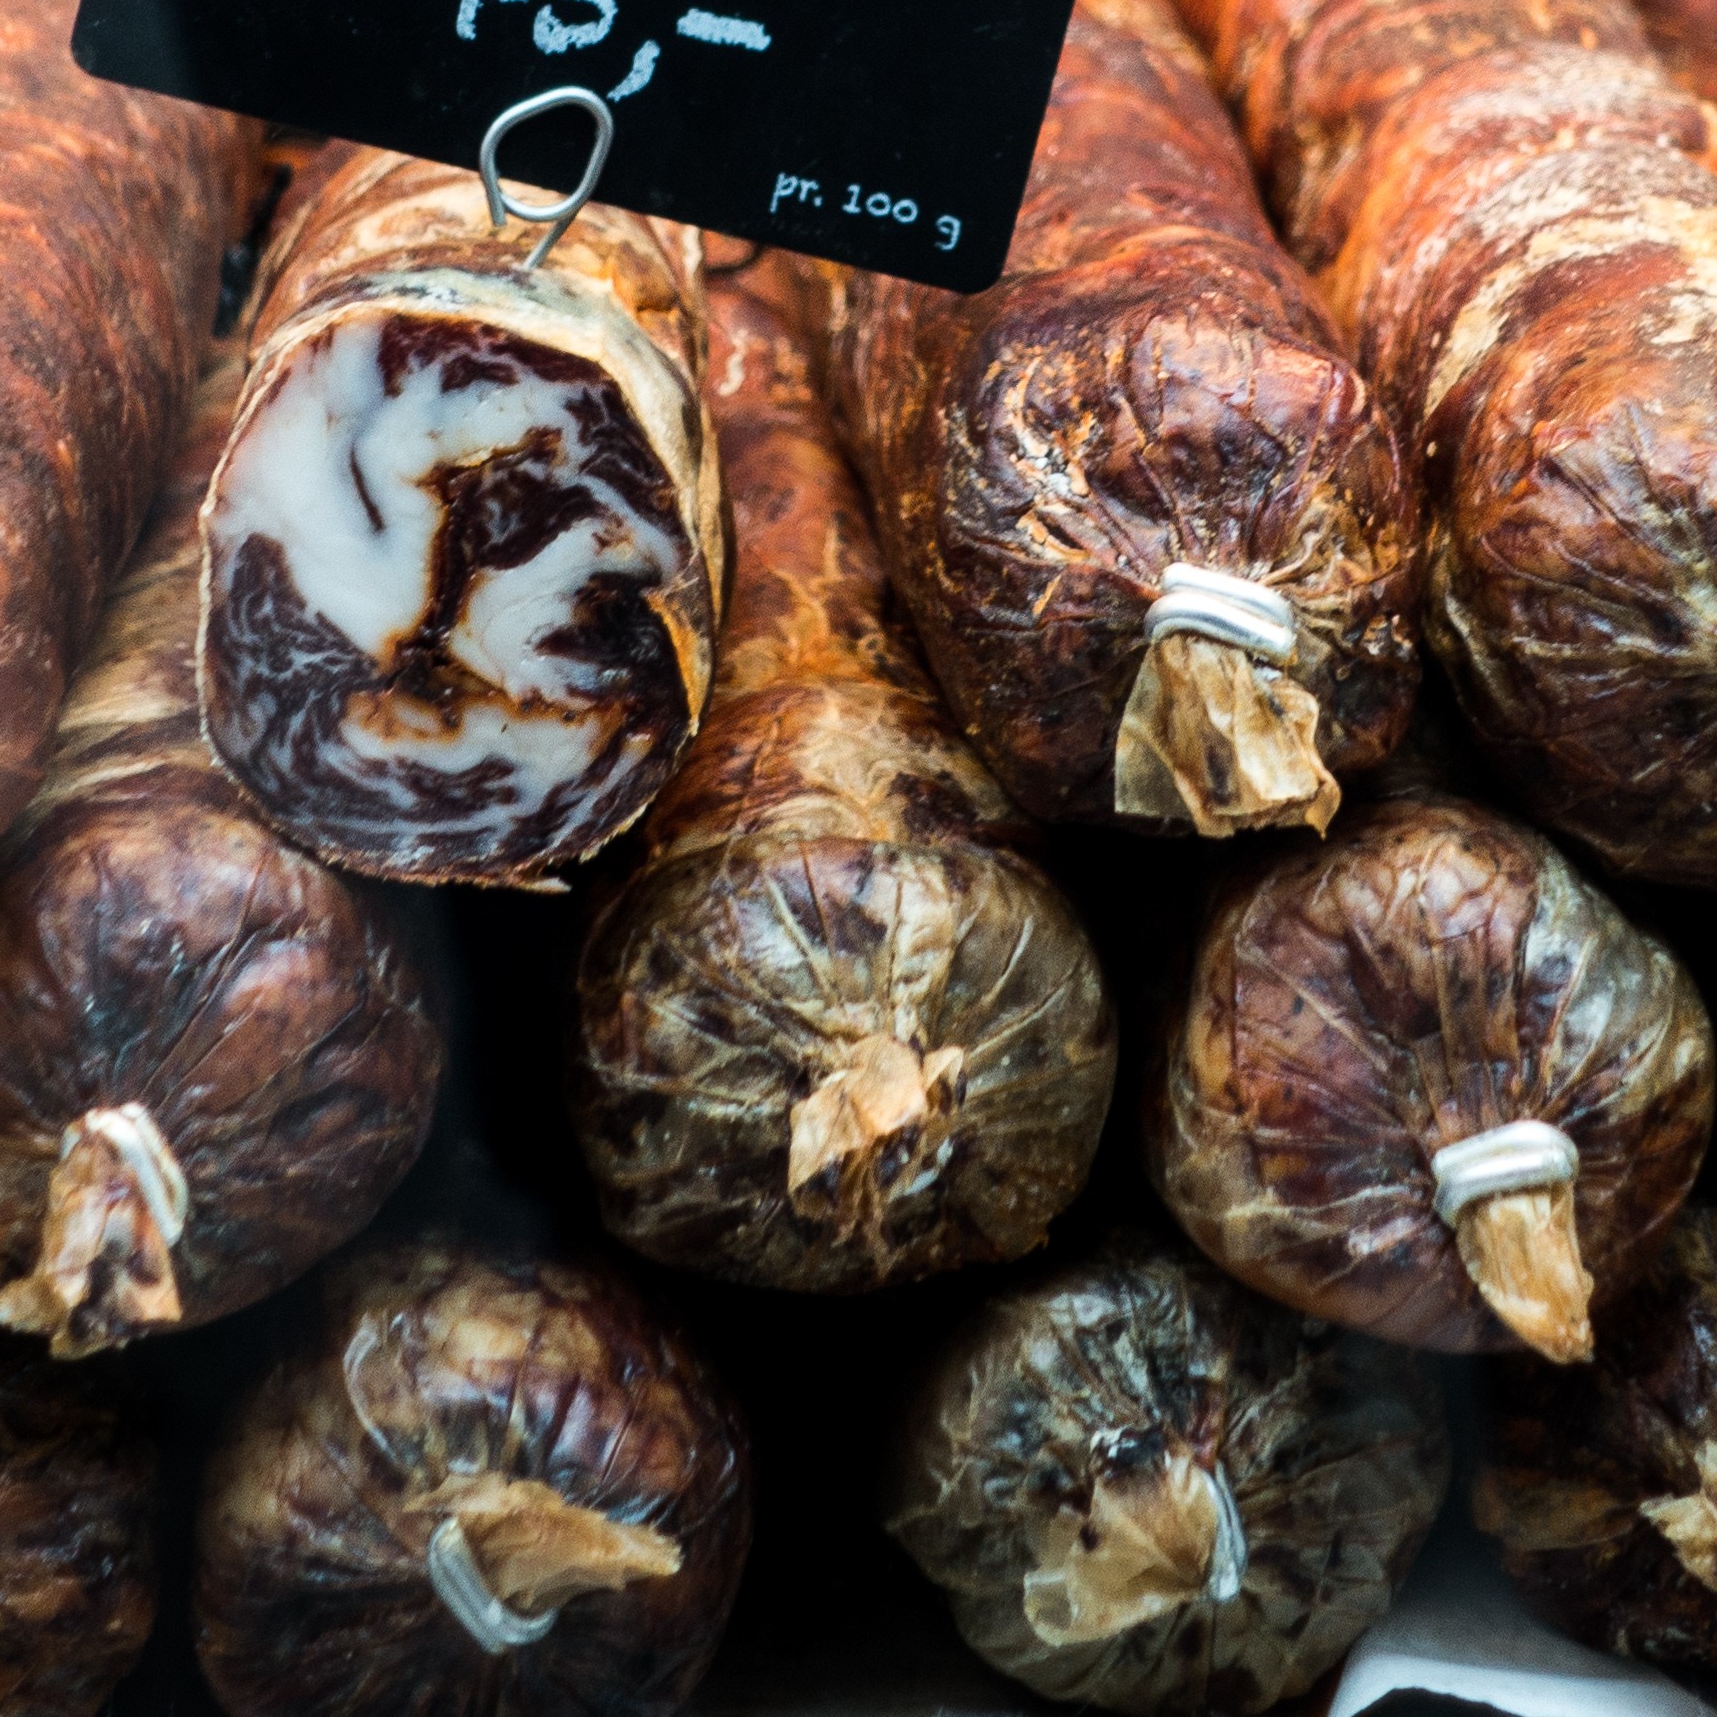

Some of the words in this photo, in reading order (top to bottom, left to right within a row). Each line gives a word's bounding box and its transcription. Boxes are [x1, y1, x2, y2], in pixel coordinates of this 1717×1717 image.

[769, 171, 823, 213] pr.
[842, 184, 919, 225] 100
[935, 213, 962, 251] g
